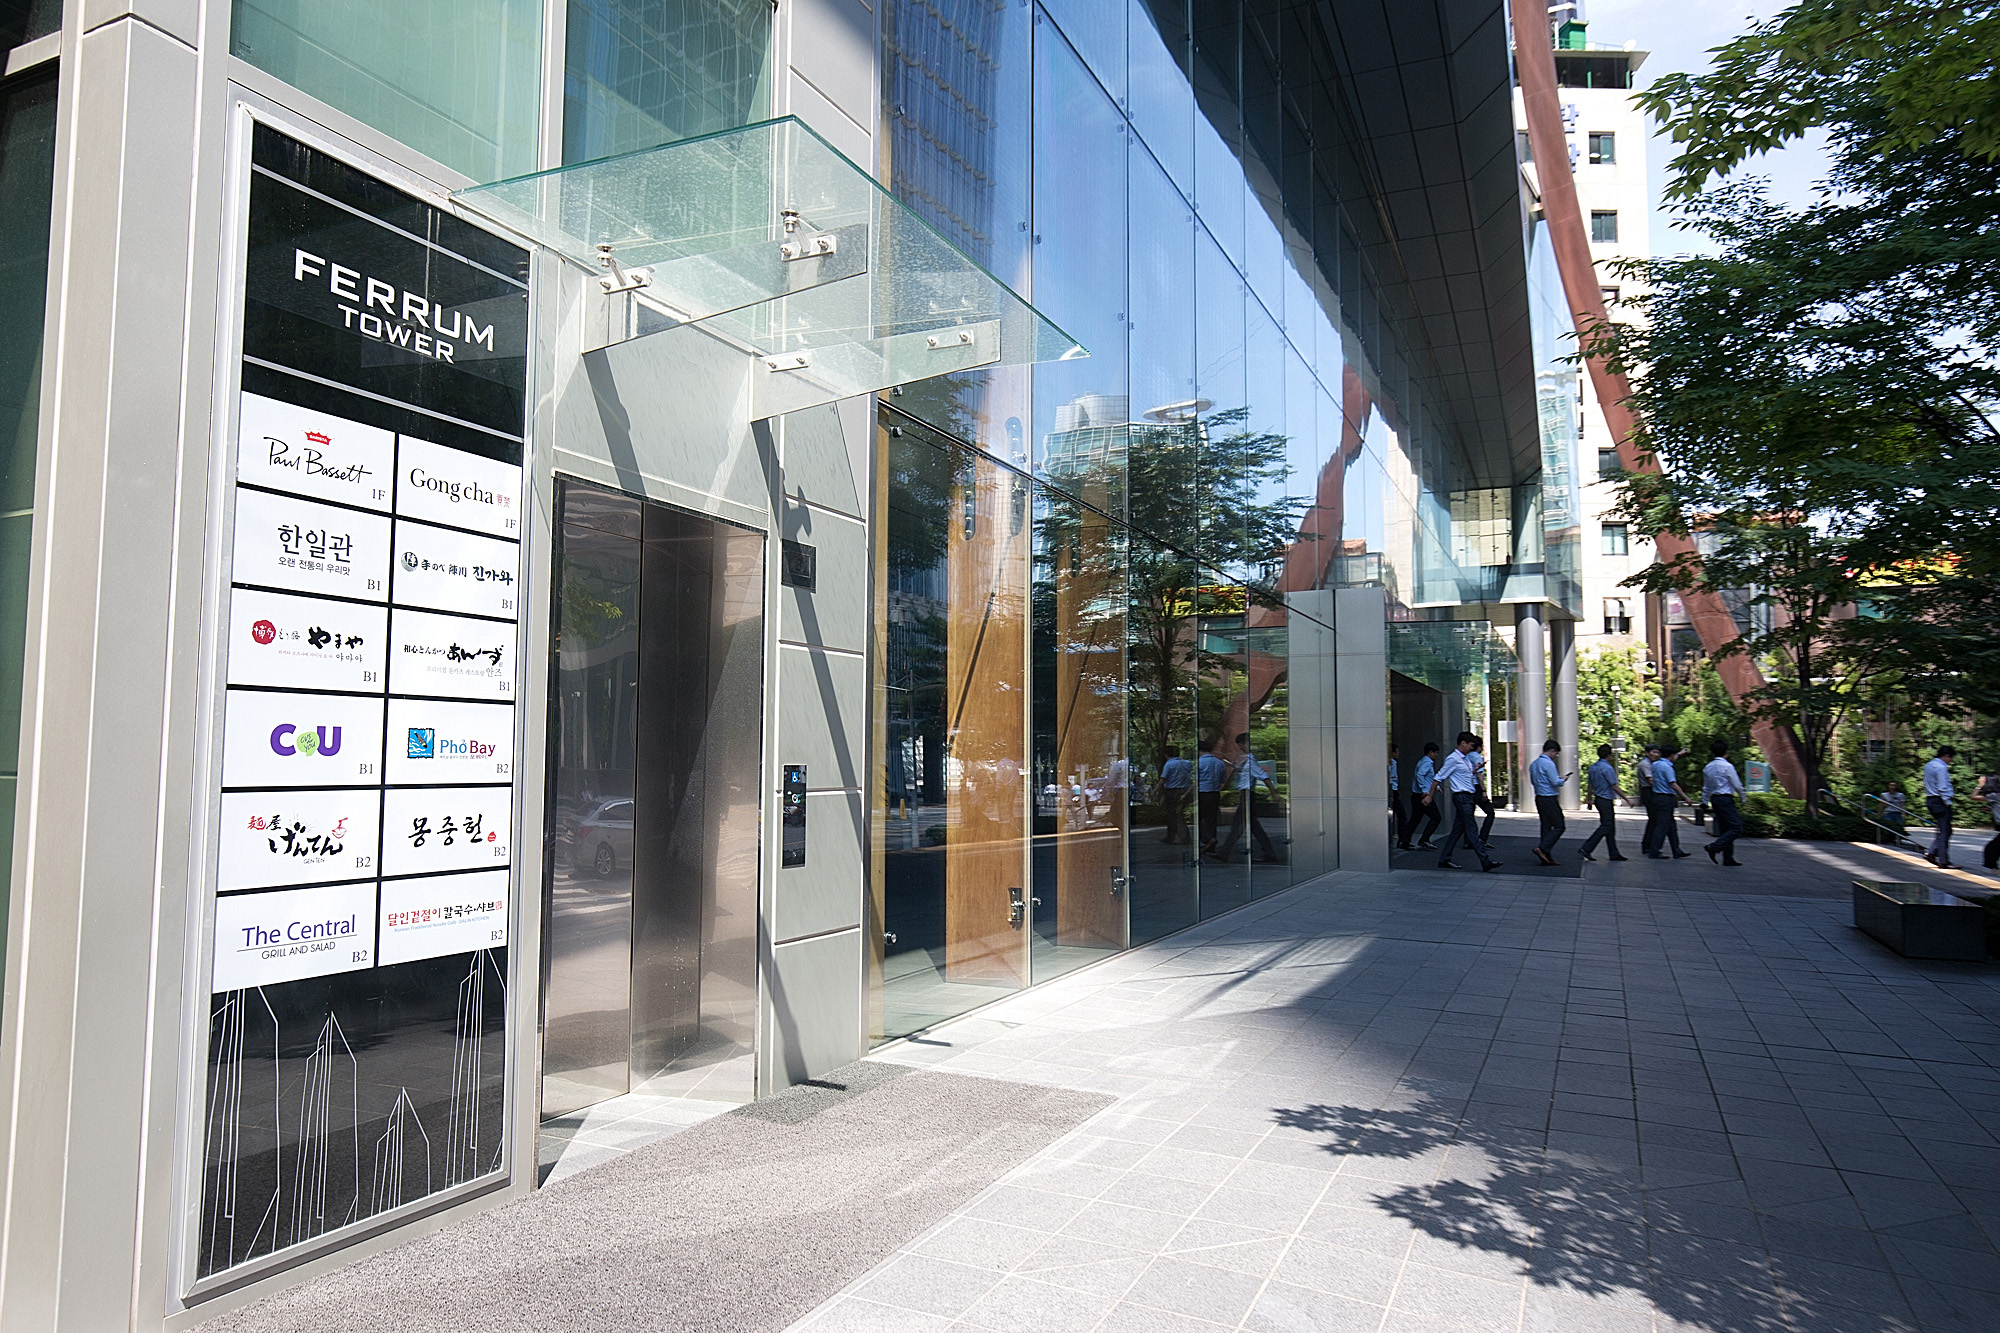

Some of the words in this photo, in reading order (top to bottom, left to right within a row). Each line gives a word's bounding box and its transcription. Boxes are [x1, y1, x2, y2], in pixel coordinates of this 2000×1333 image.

[294, 247, 495, 352] FERRUM
[337, 303, 455, 365] TOWER
[263, 436, 301, 471] Paul
[303, 447, 373, 484] Bassett
[372, 488, 386, 501] 1F
[410, 468, 461, 503] Gong
[463, 482, 494, 505] cha
[505, 518, 517, 529] 1F
[277, 524, 354, 563] 한일관
[299, 559, 324, 572] 전통의
[326, 563, 351, 576] 우리맛
[472, 565, 514, 587] 진가와
[367, 578, 381, 591] B1
[501, 598, 513, 610] B1
[307, 626, 364, 649] やまや
[335, 652, 363, 663] 야마야
[363, 670, 377, 683] B1
[499, 680, 511, 692] B1
[270, 723, 342, 756] CU
[469, 740, 496, 757] Bay
[359, 763, 373, 774] B1
[496, 763, 509, 774] B2
[408, 813, 483, 847] 몽중헌
[267, 821, 344, 857] げんてん
[493, 846, 507, 857] B2
[355, 856, 371, 868] B2
[387, 907, 441, 927] 달인겉절이
[241, 925, 281, 947] The
[287, 914, 356, 941] Central
[490, 929, 504, 941] B2
[261, 947, 287, 960] GRILL
[288, 945, 309, 956] AND
[310, 941, 336, 953] SALAD
[352, 950, 368, 963] B2
